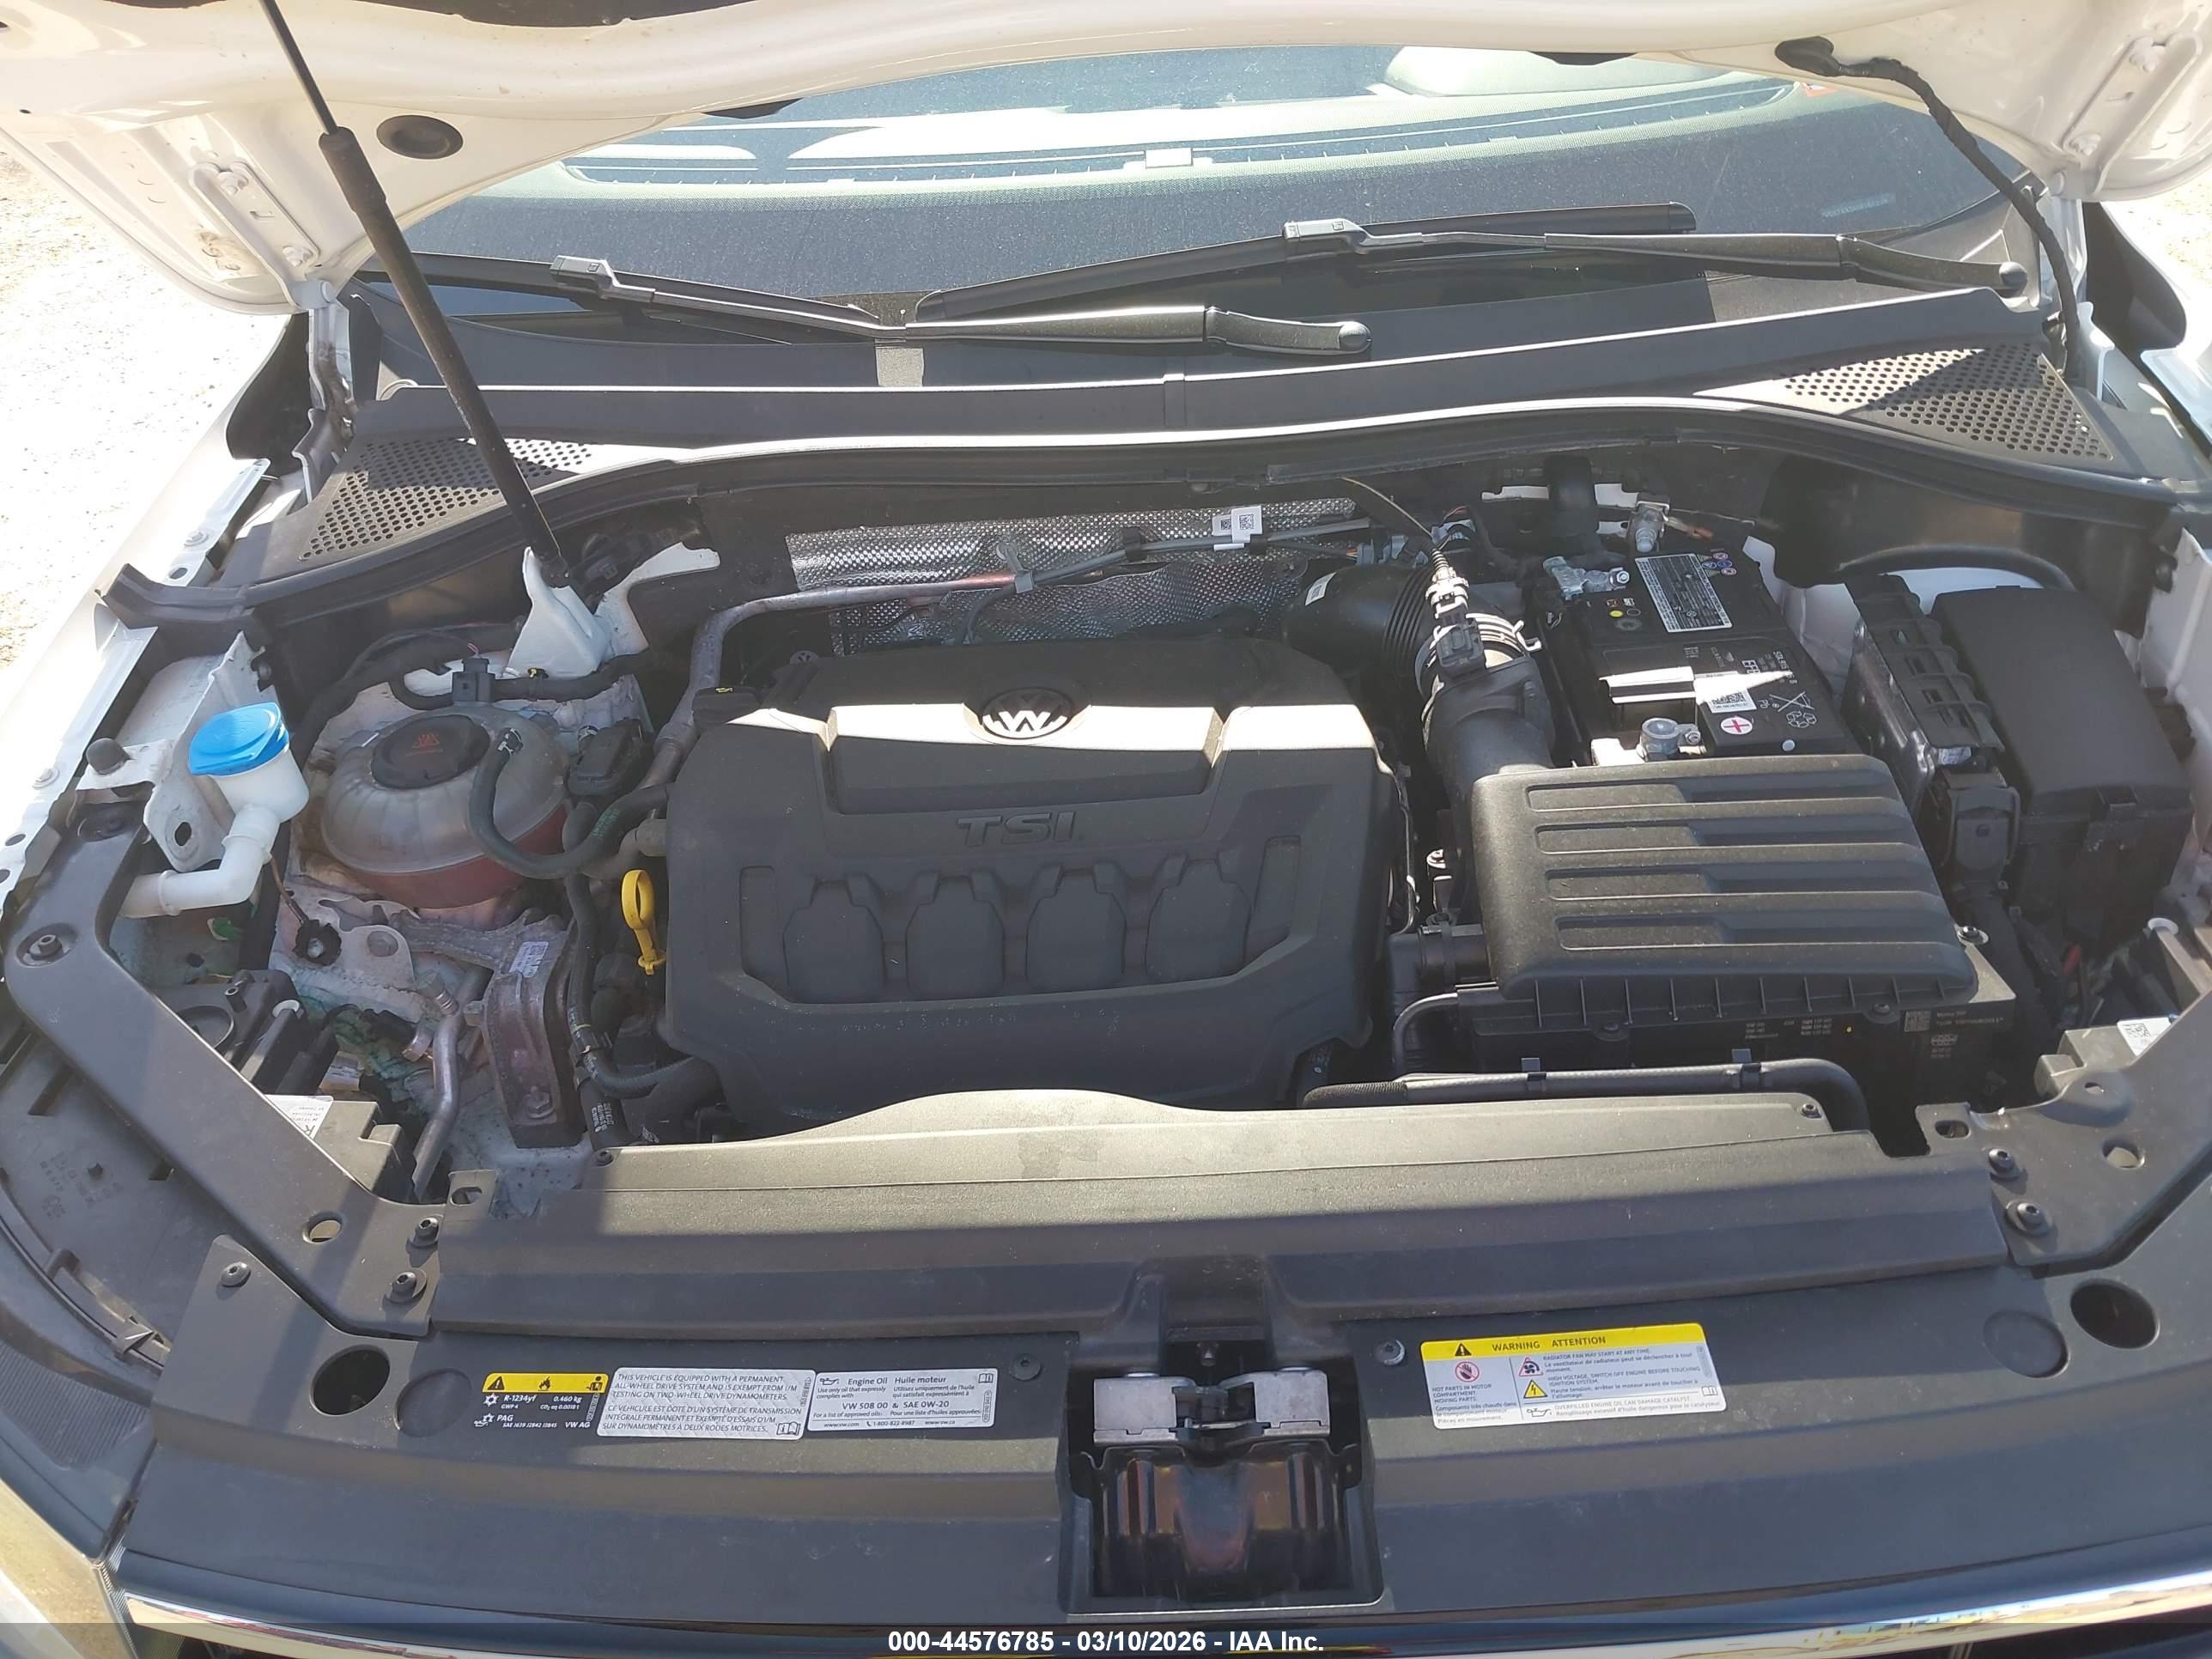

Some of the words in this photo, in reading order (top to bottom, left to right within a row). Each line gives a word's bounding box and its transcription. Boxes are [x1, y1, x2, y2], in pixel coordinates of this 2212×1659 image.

[956, 811, 1078, 848] TSI
[1492, 1340, 1540, 1352] WARNING
[1552, 1336, 1606, 1347] ATTENTION
[848, 1378, 875, 1387] Engine
[504, 1395, 538, 1404] R-1234yf
[618, 1404, 653, 1413] VÉHICULE
[707, 1405, 737, 1413] SYSTÈME
[605, 1413, 643, 1421] INTÉGRALE
[696, 1414, 726, 1423] EXEMPTÉ
[618, 1422, 676, 1431] DYNAMOMÈTRES
